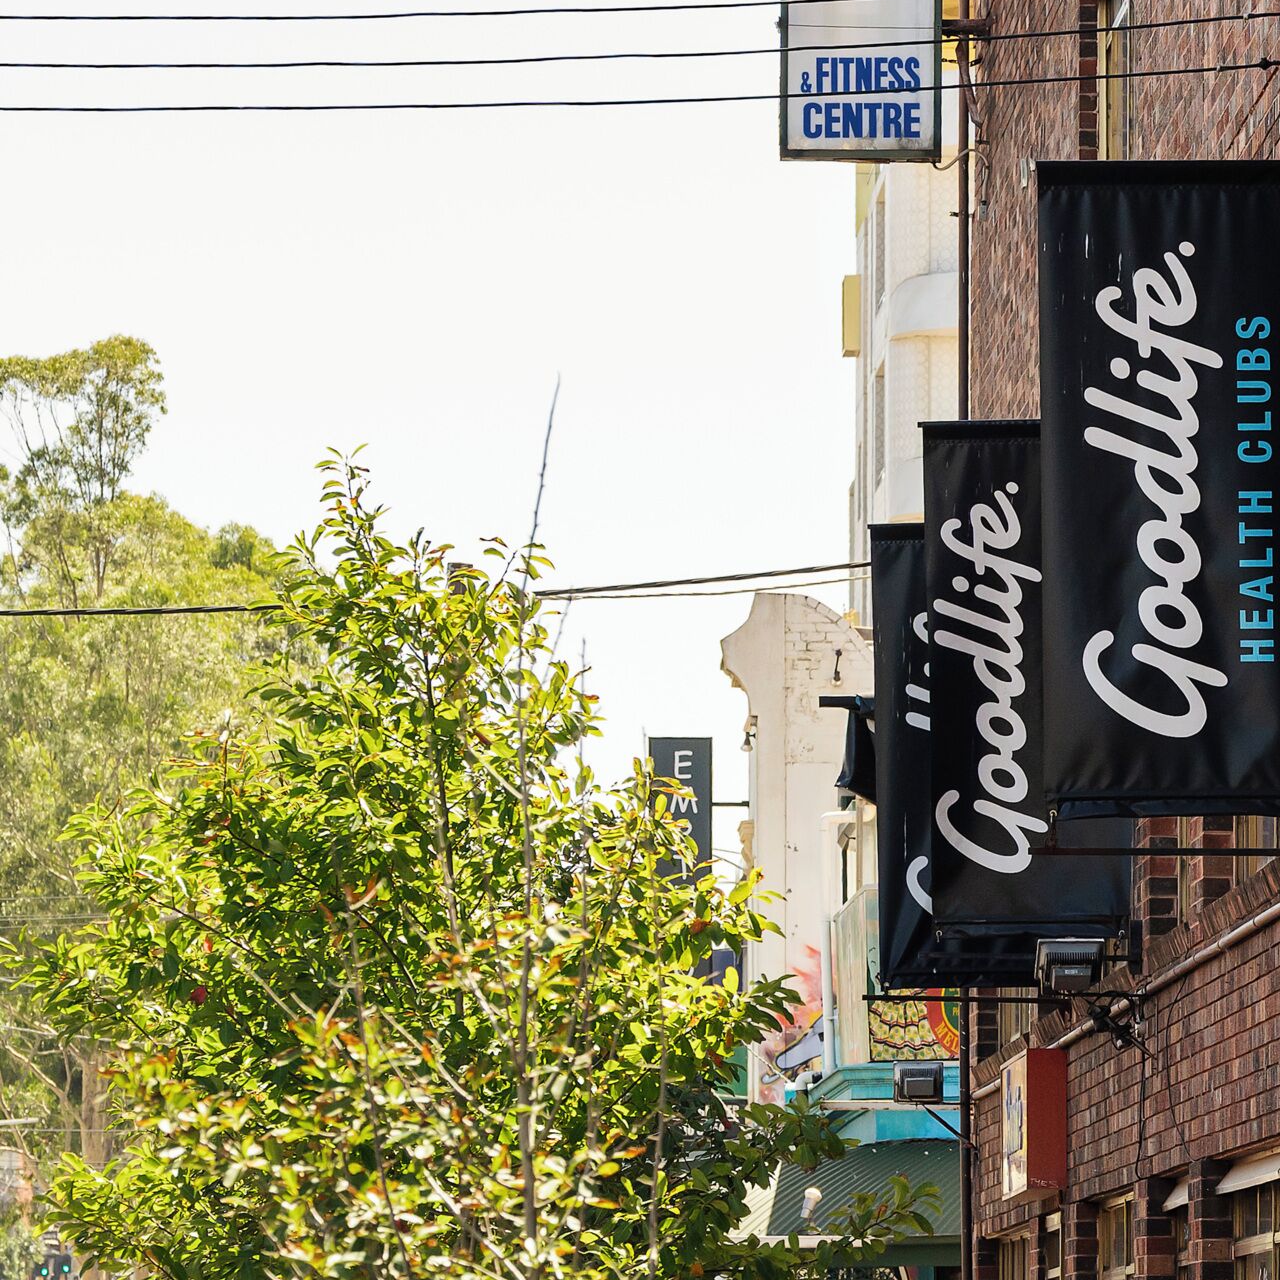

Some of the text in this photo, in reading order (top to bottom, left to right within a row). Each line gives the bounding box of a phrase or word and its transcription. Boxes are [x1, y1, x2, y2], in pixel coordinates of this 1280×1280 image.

[800, 57, 921, 93] & FITNESS
[803, 102, 921, 138] CENTRE
[1237, 315, 1275, 663] HEALTH CLUBS
